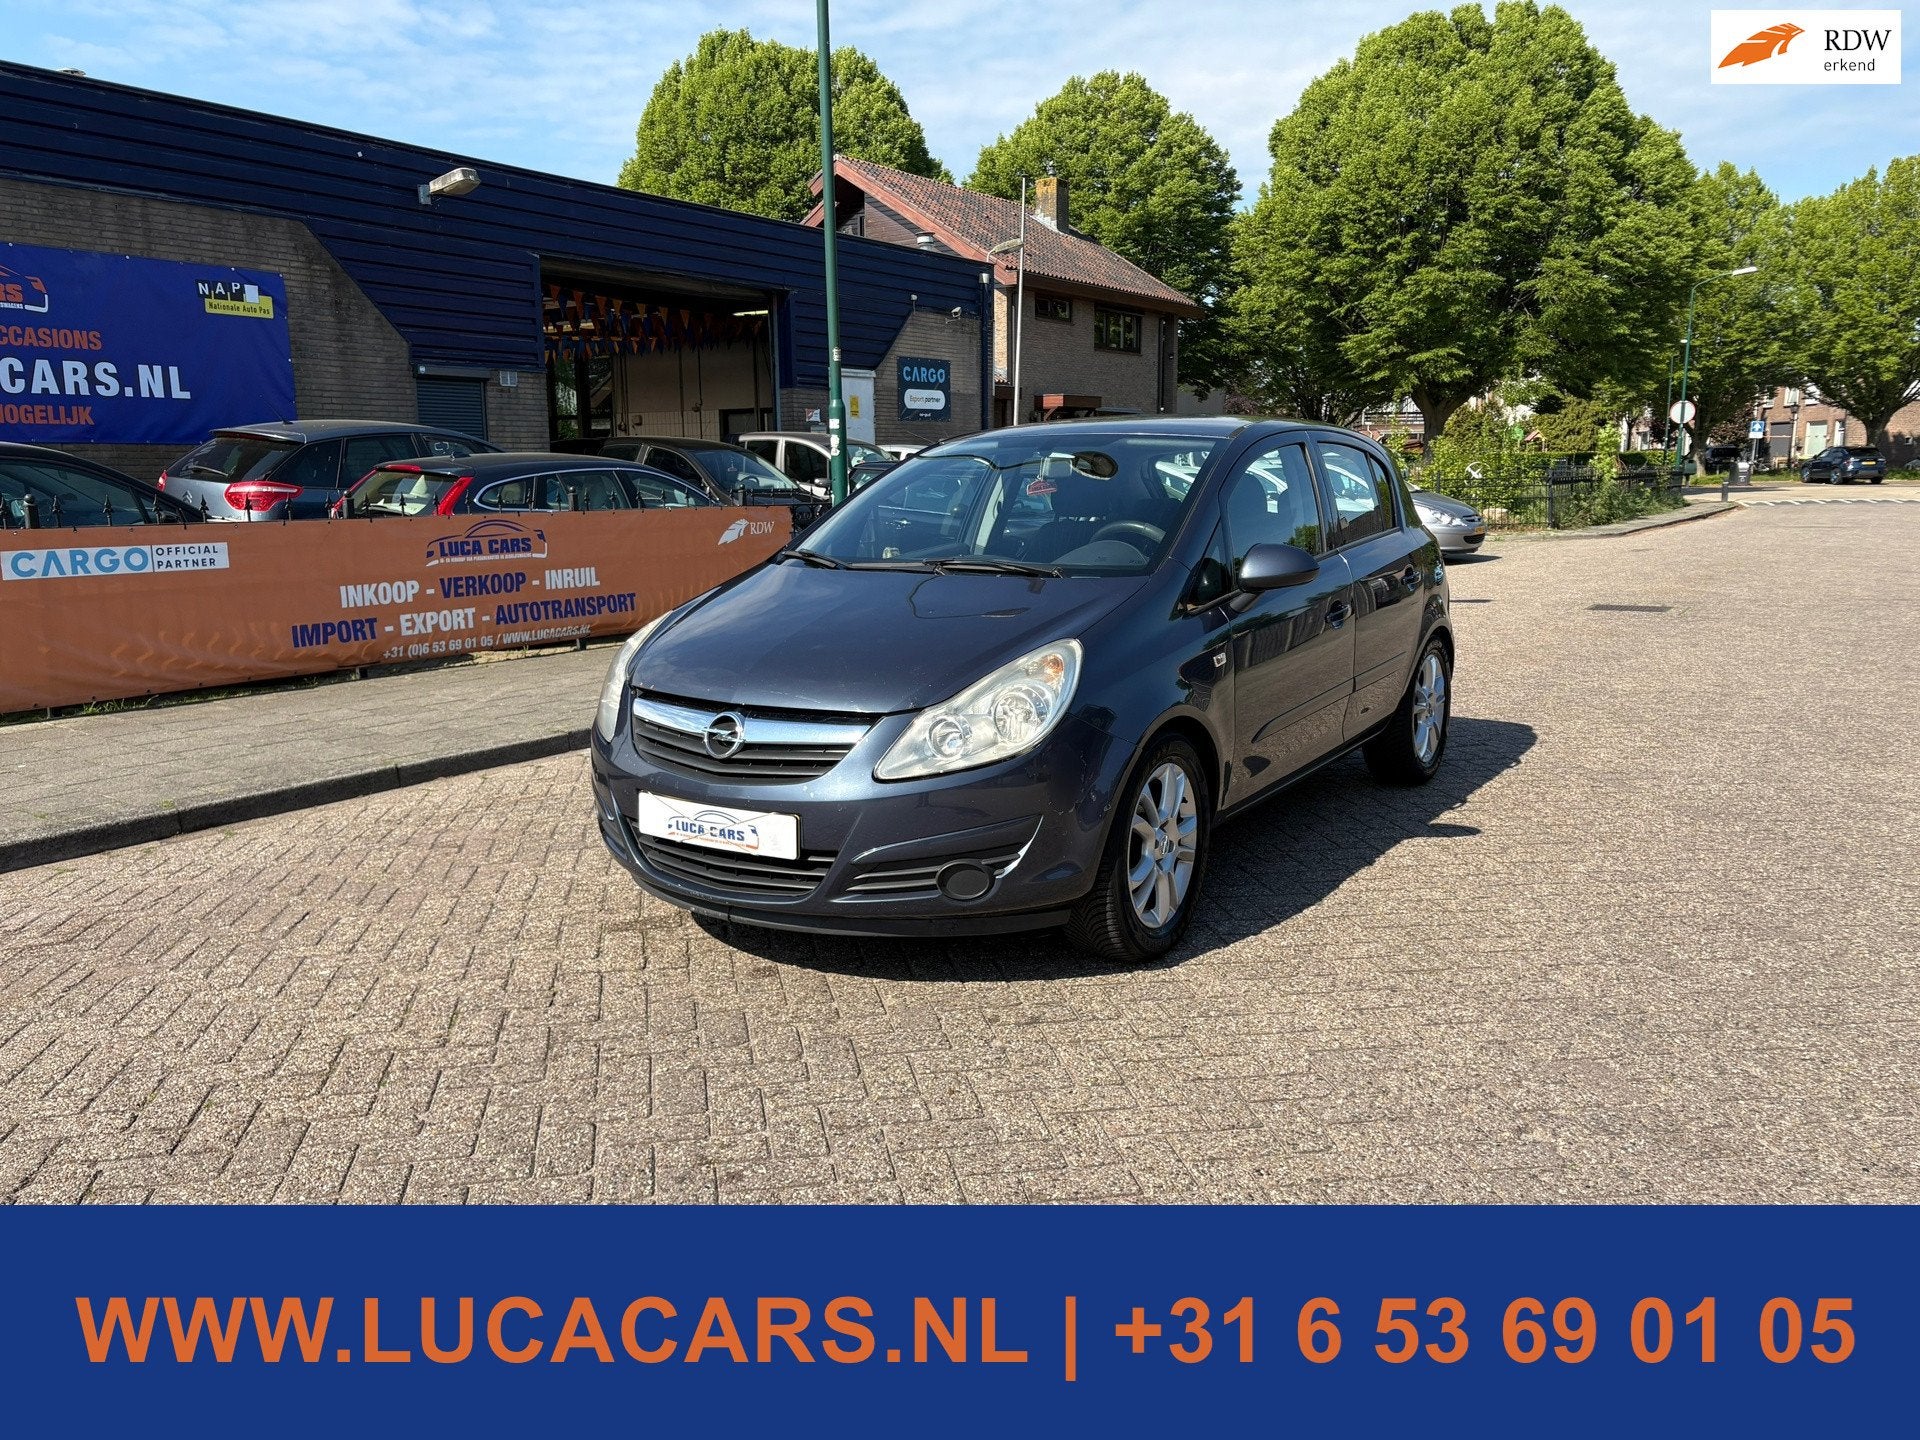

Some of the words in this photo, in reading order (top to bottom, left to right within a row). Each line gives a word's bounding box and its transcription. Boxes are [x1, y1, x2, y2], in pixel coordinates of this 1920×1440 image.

[208, 302, 241, 312] Nationale
[243, 305, 258, 314] Auto
[259, 306, 270, 315] Pas
[0, 357, 191, 400] CARS.NL
[903, 366, 945, 383] CARGO
[0, 403, 95, 425] OGELIJK
[750, 521, 775, 535] RDW
[439, 540, 483, 557] LUCA
[488, 537, 532, 554] CARS
[10, 547, 149, 578] CARGO
[156, 545, 218, 556] OFFICIAL
[157, 558, 216, 569] PARTNER
[339, 580, 419, 608] INKOOP
[439, 572, 527, 600] VERKOOP
[545, 567, 600, 590] INRUIL
[291, 617, 377, 648] IMPORT
[400, 607, 476, 636] EXPORT
[495, 593, 636, 626] AUTOTRANSPORT
[383, 645, 404, 659] +31
[407, 643, 430, 658] (0)6
[432, 641, 446, 653] 53
[449, 639, 462, 651] 69
[464, 637, 477, 648] 01
[480, 635, 493, 647] 05
[502, 624, 591, 645] WWW.LUCACARS.NL
[676, 820, 705, 835] LUCA
[709, 826, 745, 841] CARS
